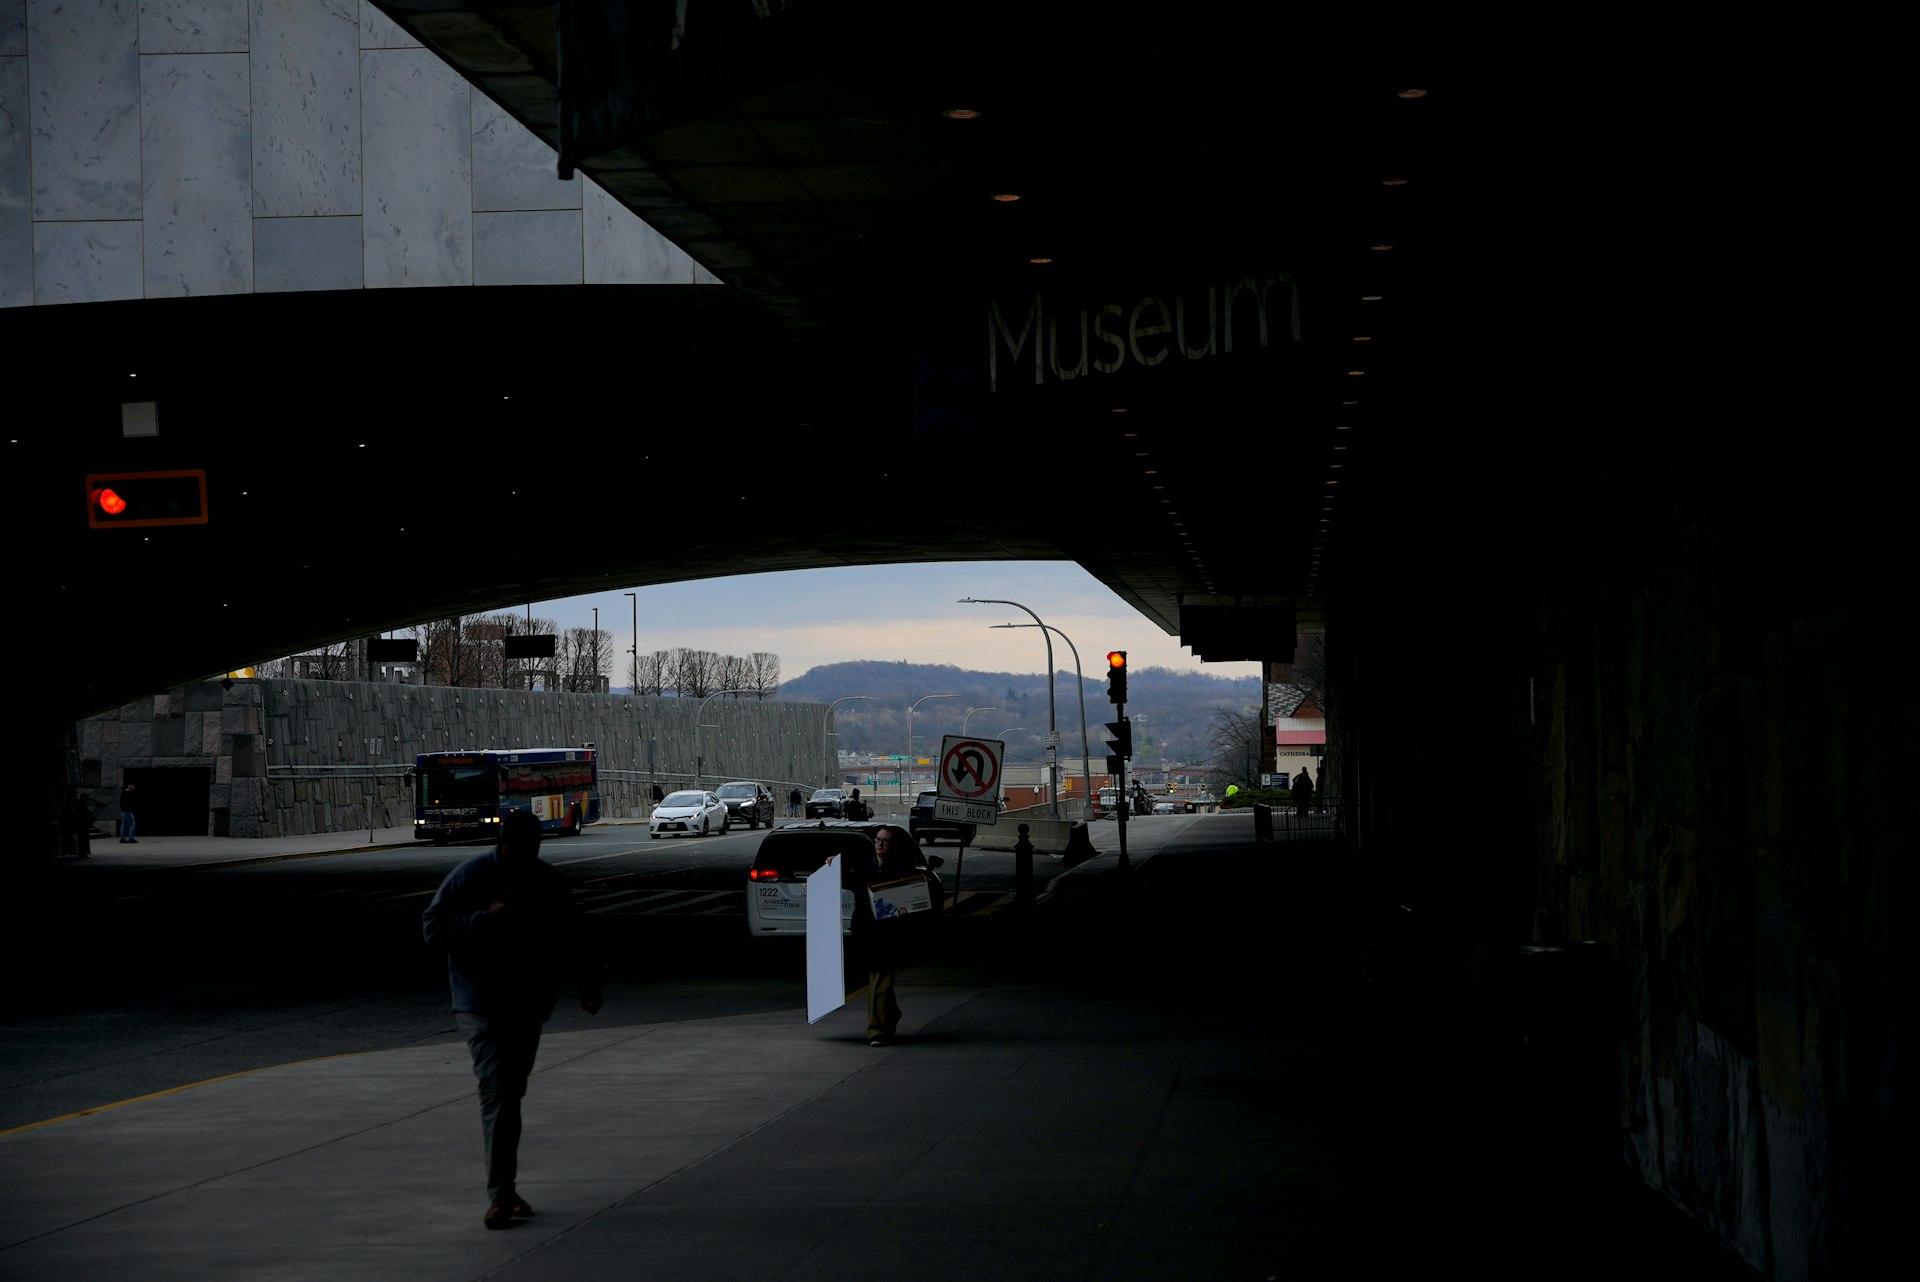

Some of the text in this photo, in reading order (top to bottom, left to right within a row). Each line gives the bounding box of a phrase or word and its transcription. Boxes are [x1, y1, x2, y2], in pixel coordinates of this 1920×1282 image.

[988, 271, 1302, 393] Museum
[942, 804, 992, 820] THIS BLOCK
[758, 887, 778, 897] 1222
